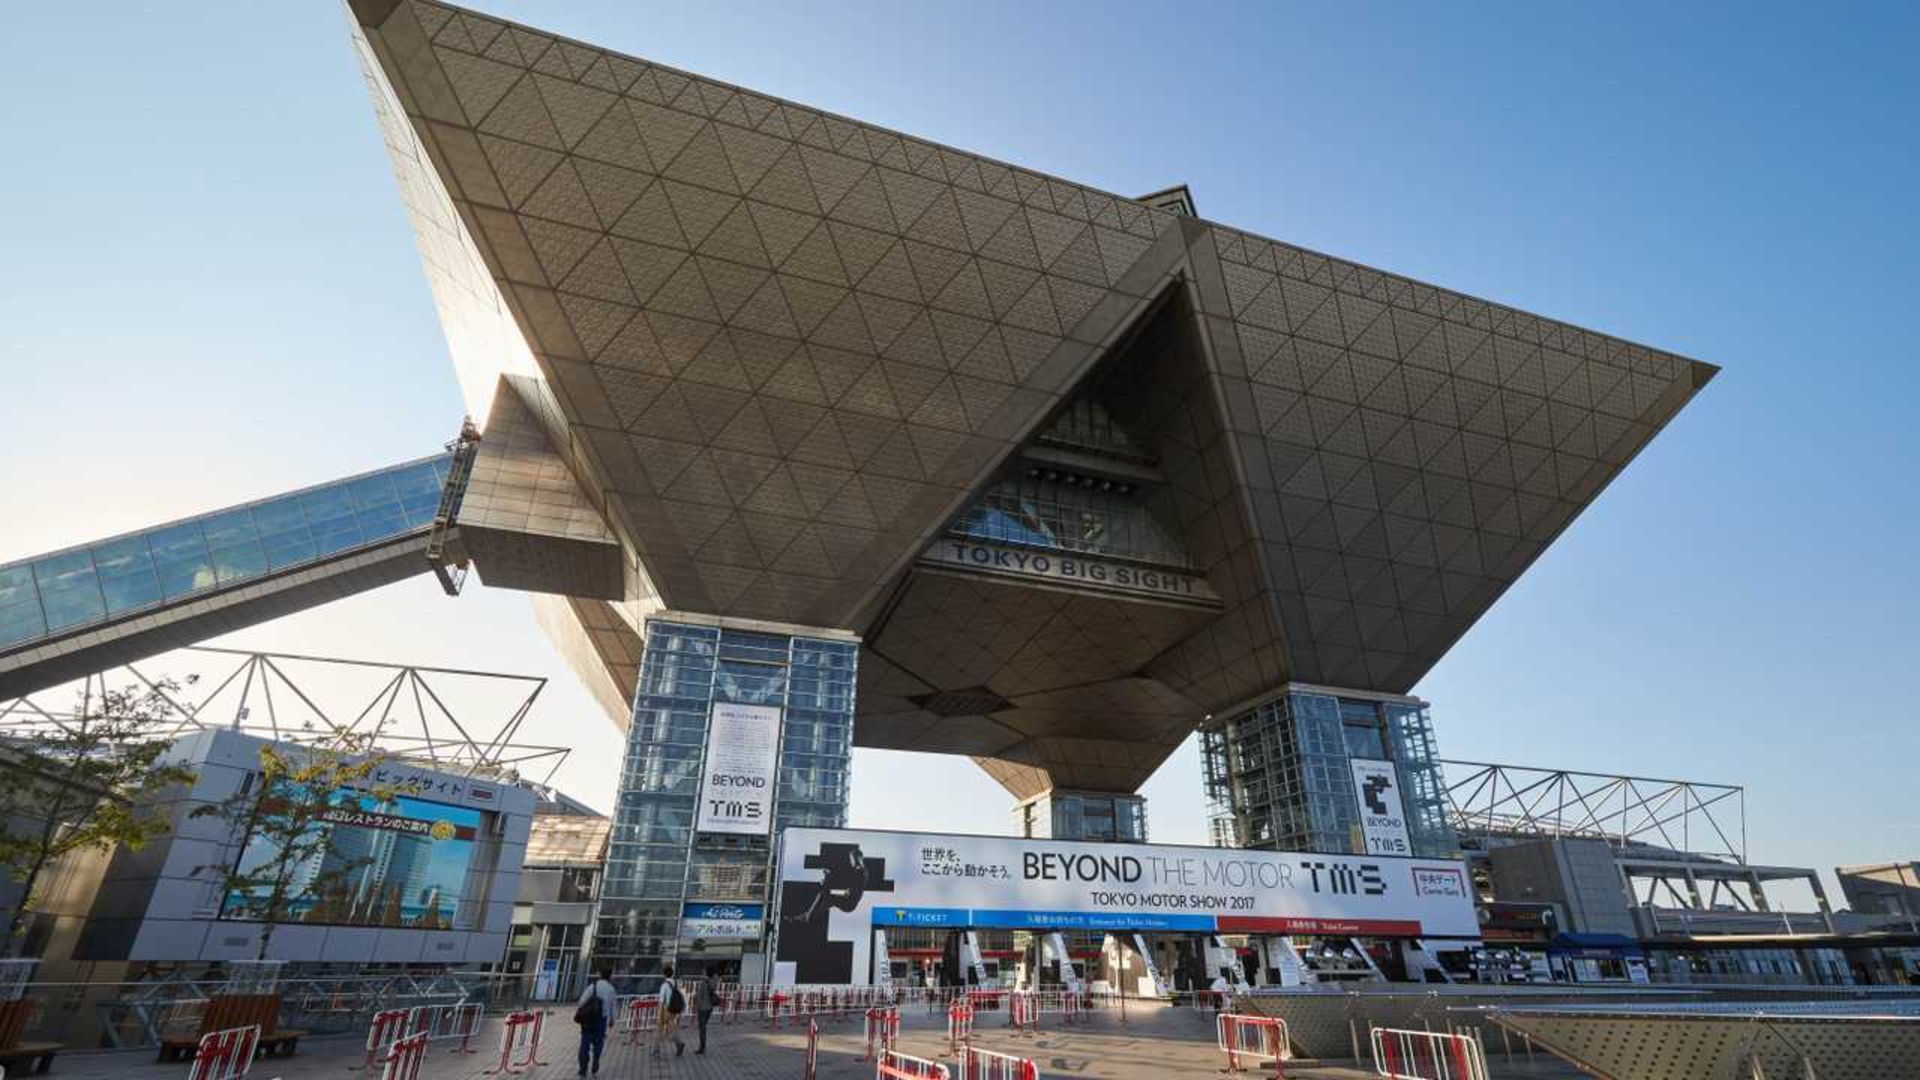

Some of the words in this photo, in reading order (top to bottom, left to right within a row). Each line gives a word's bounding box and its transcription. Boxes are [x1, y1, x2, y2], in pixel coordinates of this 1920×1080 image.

[953, 543, 1051, 573] TOKYO
[1061, 559, 1107, 580] BIG
[1115, 568, 1194, 594] SIGHT
[712, 774, 766, 789] BEYOND
[709, 799, 763, 818] TMS
[1366, 816, 1402, 828] BEYOND
[1370, 837, 1407, 852] TMS
[921, 847, 961, 862] 世界を、
[921, 863, 1012, 879] ここから動かそう。
[1023, 852, 1142, 883] BEYOND
[1146, 855, 1195, 887] THE
[1203, 859, 1294, 889] MOTOR
[1300, 862, 1387, 896] TMS
[1091, 892, 1137, 907] TOKYO
[1140, 893, 1188, 909] MOTOR
[1190, 895, 1228, 910] SHOW
[1230, 897, 1256, 910] 2017
